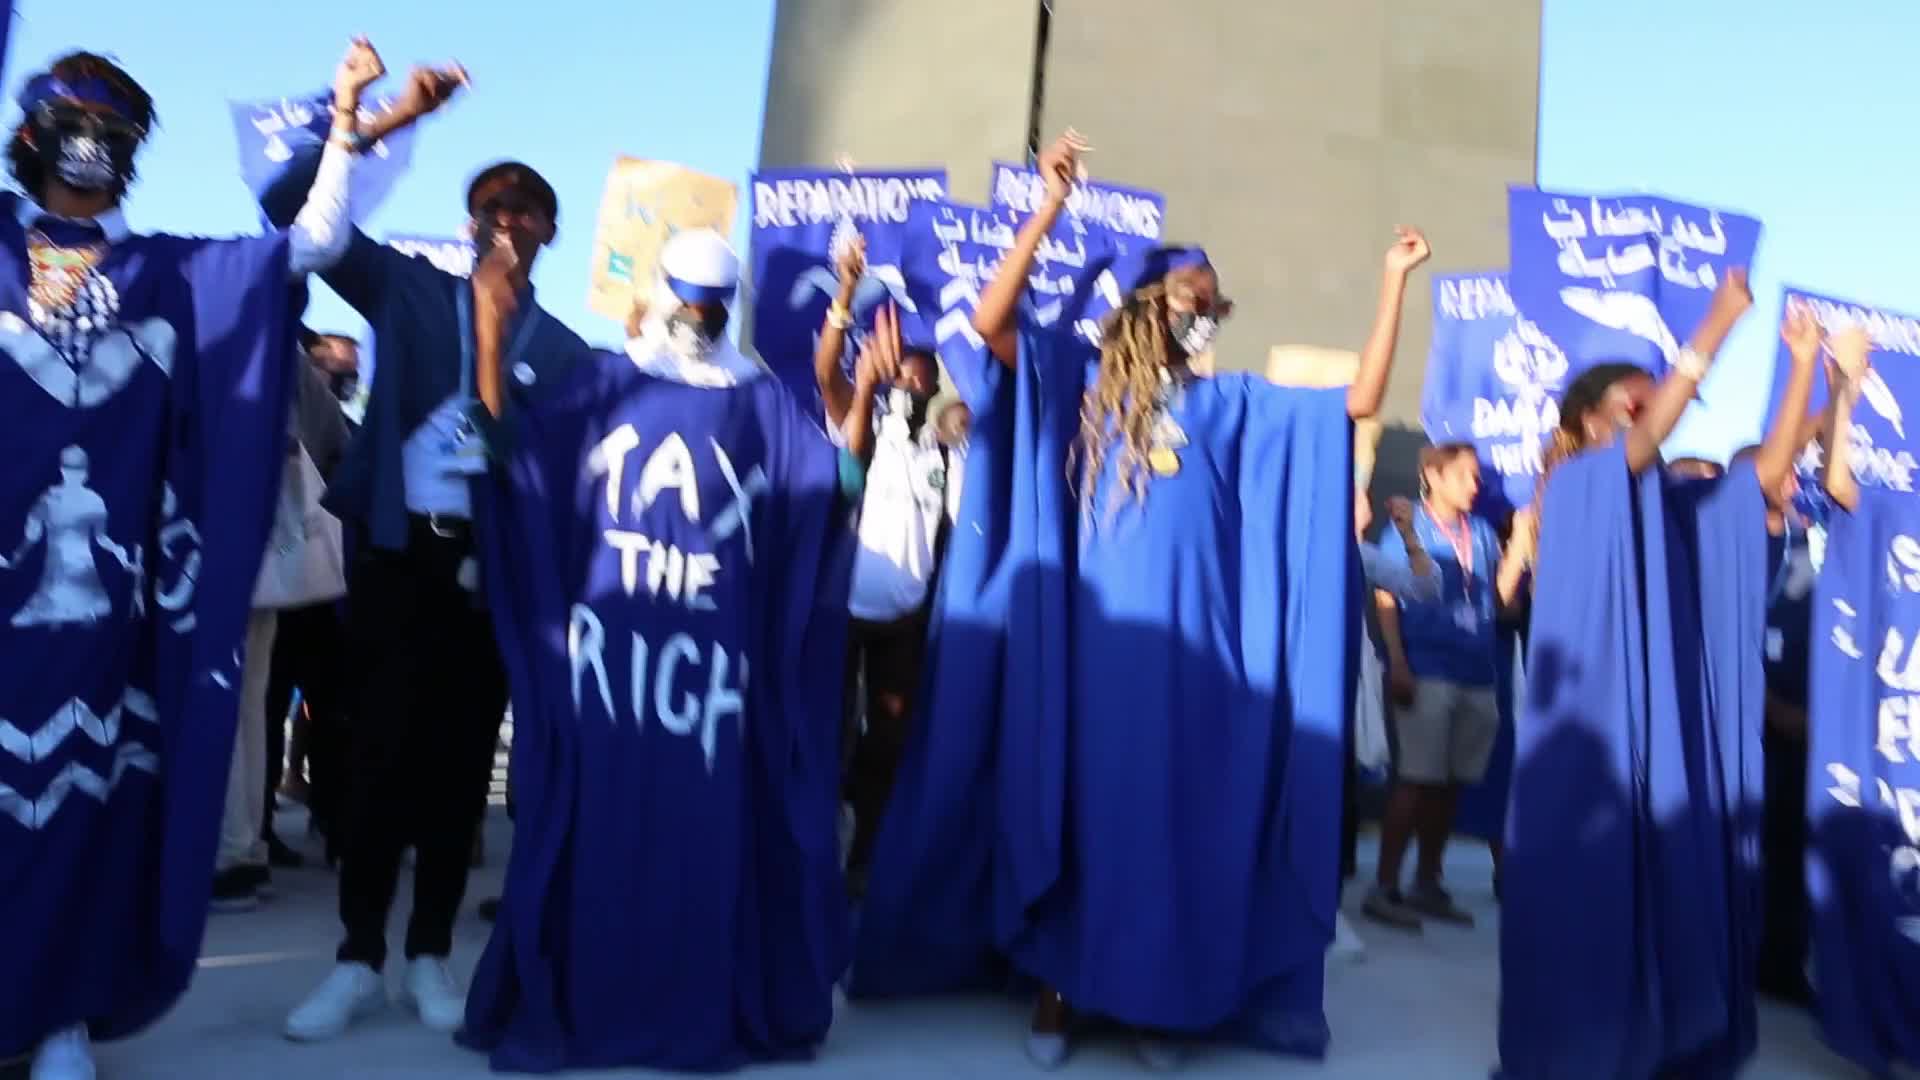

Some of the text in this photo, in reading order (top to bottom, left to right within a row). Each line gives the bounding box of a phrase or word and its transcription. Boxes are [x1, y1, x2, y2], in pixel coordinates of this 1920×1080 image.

[588, 422, 769, 566] TAX
[603, 529, 722, 611] THE
[567, 602, 749, 774] RICH
